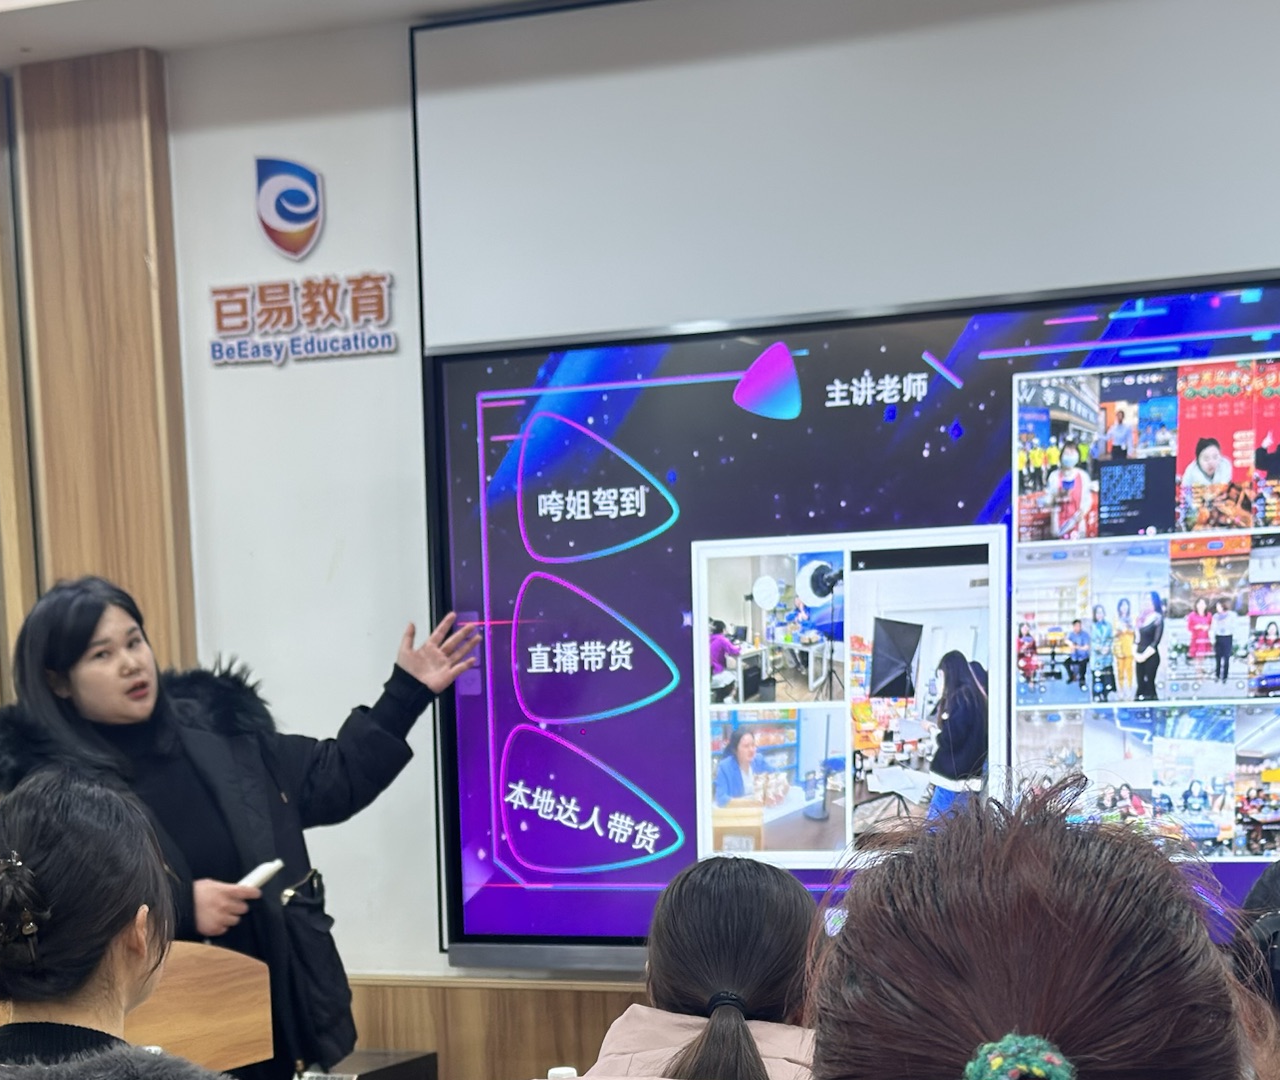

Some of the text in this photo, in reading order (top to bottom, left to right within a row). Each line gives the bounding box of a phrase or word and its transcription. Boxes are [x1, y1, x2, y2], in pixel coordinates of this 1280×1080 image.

[211, 273, 387, 333] 百易教育
[211, 332, 393, 361] BeEasy Education
[825, 372, 928, 407] 主讲老师
[527, 640, 634, 673] 直播带货
[504, 780, 660, 854] 本地达人带货
